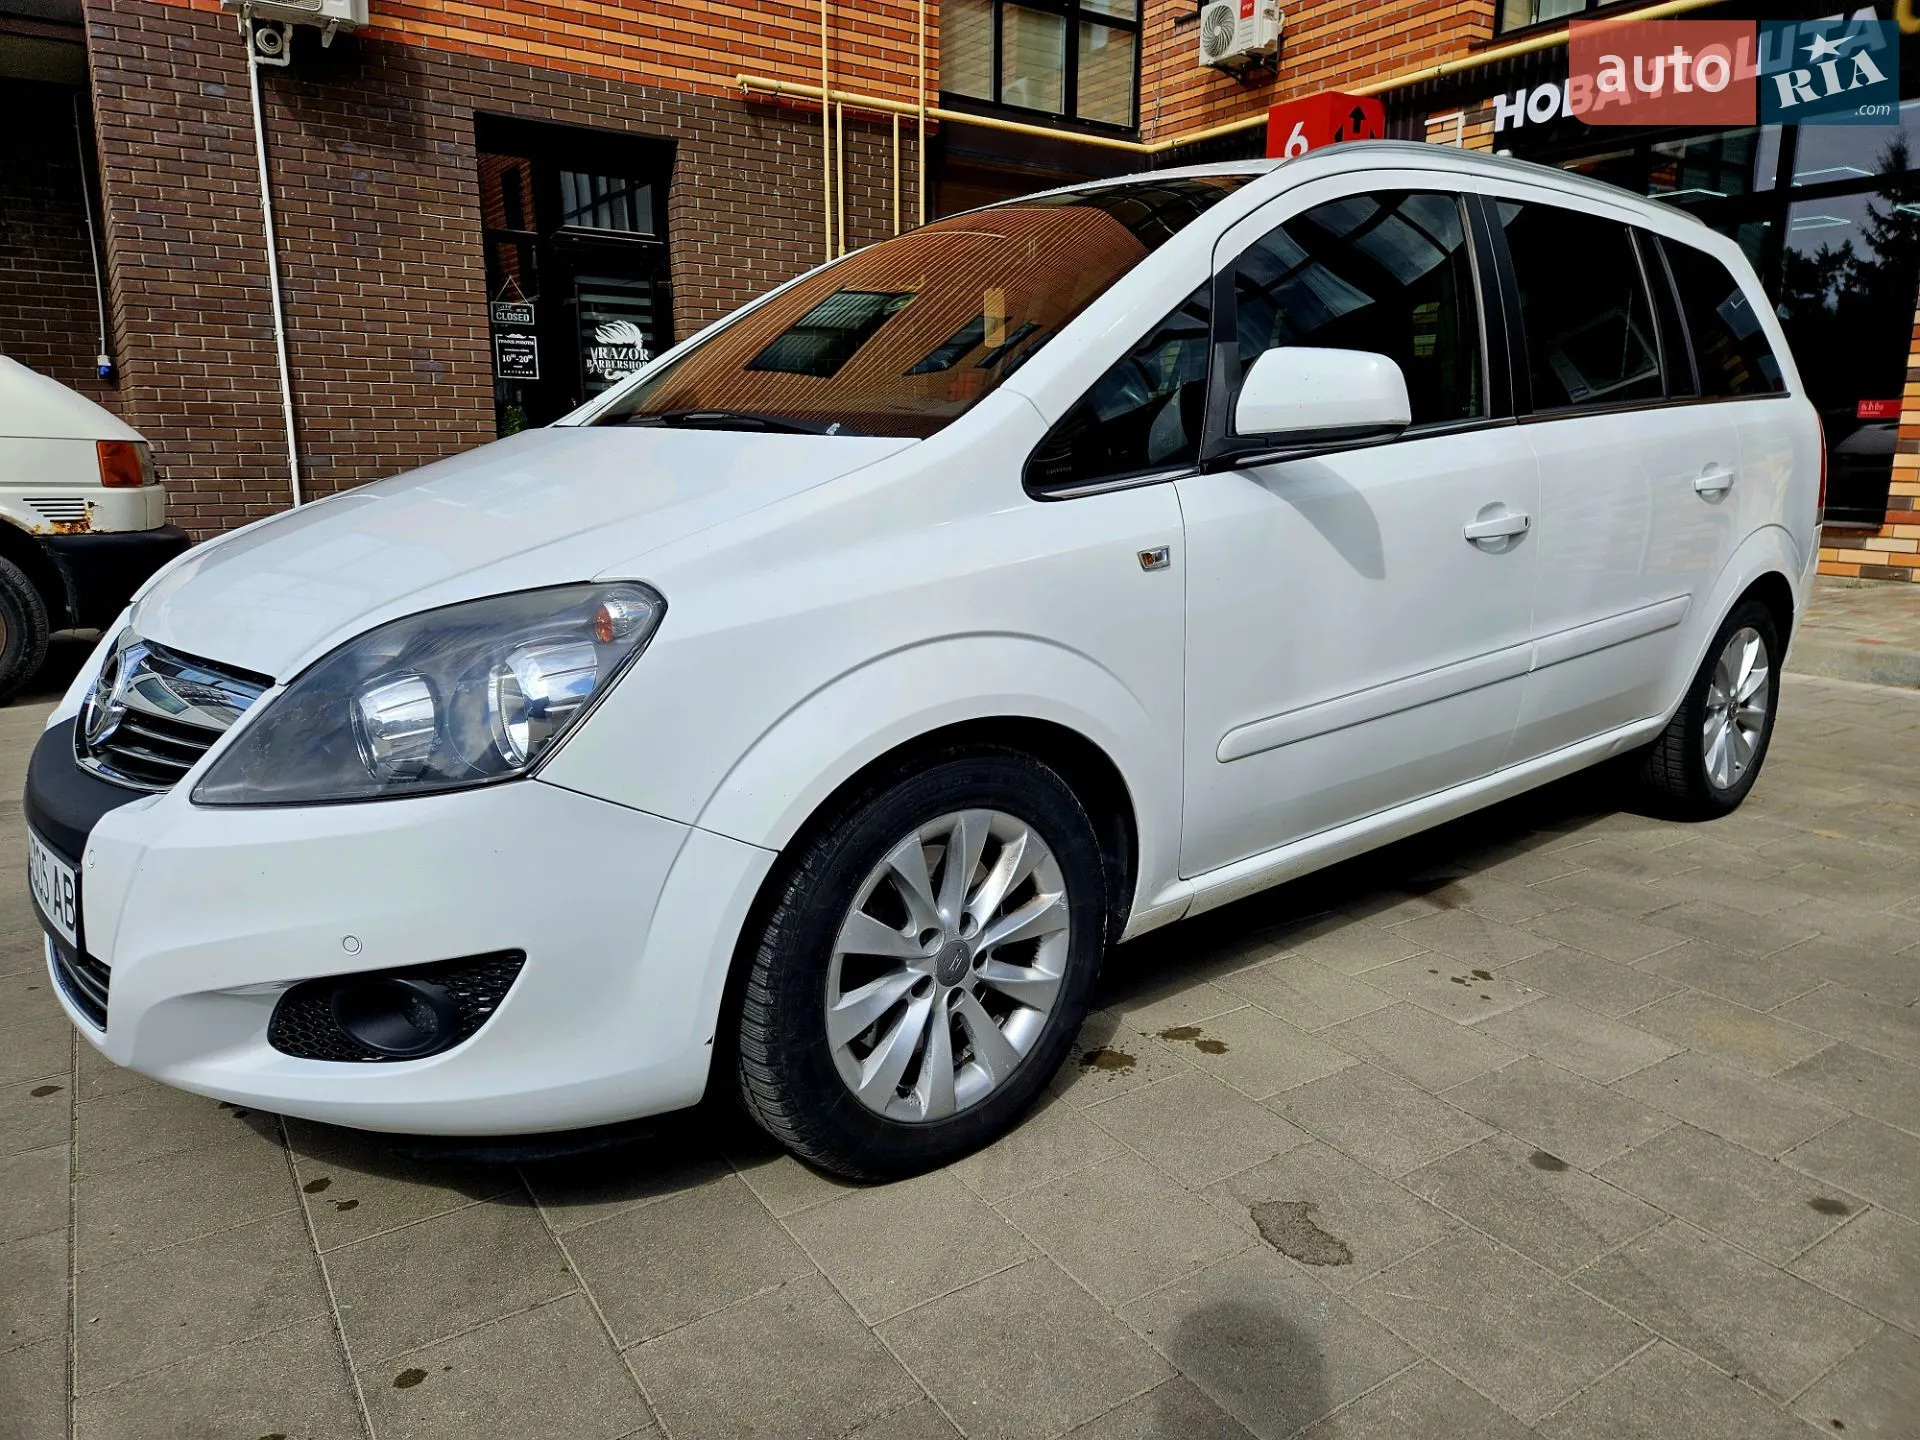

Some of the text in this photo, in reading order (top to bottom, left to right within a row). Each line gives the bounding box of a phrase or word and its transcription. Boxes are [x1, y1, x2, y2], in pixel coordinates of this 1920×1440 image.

[1284, 121, 1309, 158] 6
[496, 311, 530, 322] CLOSED
[598, 347, 650, 361] RAZOR
[54, 865, 75, 931] AB
